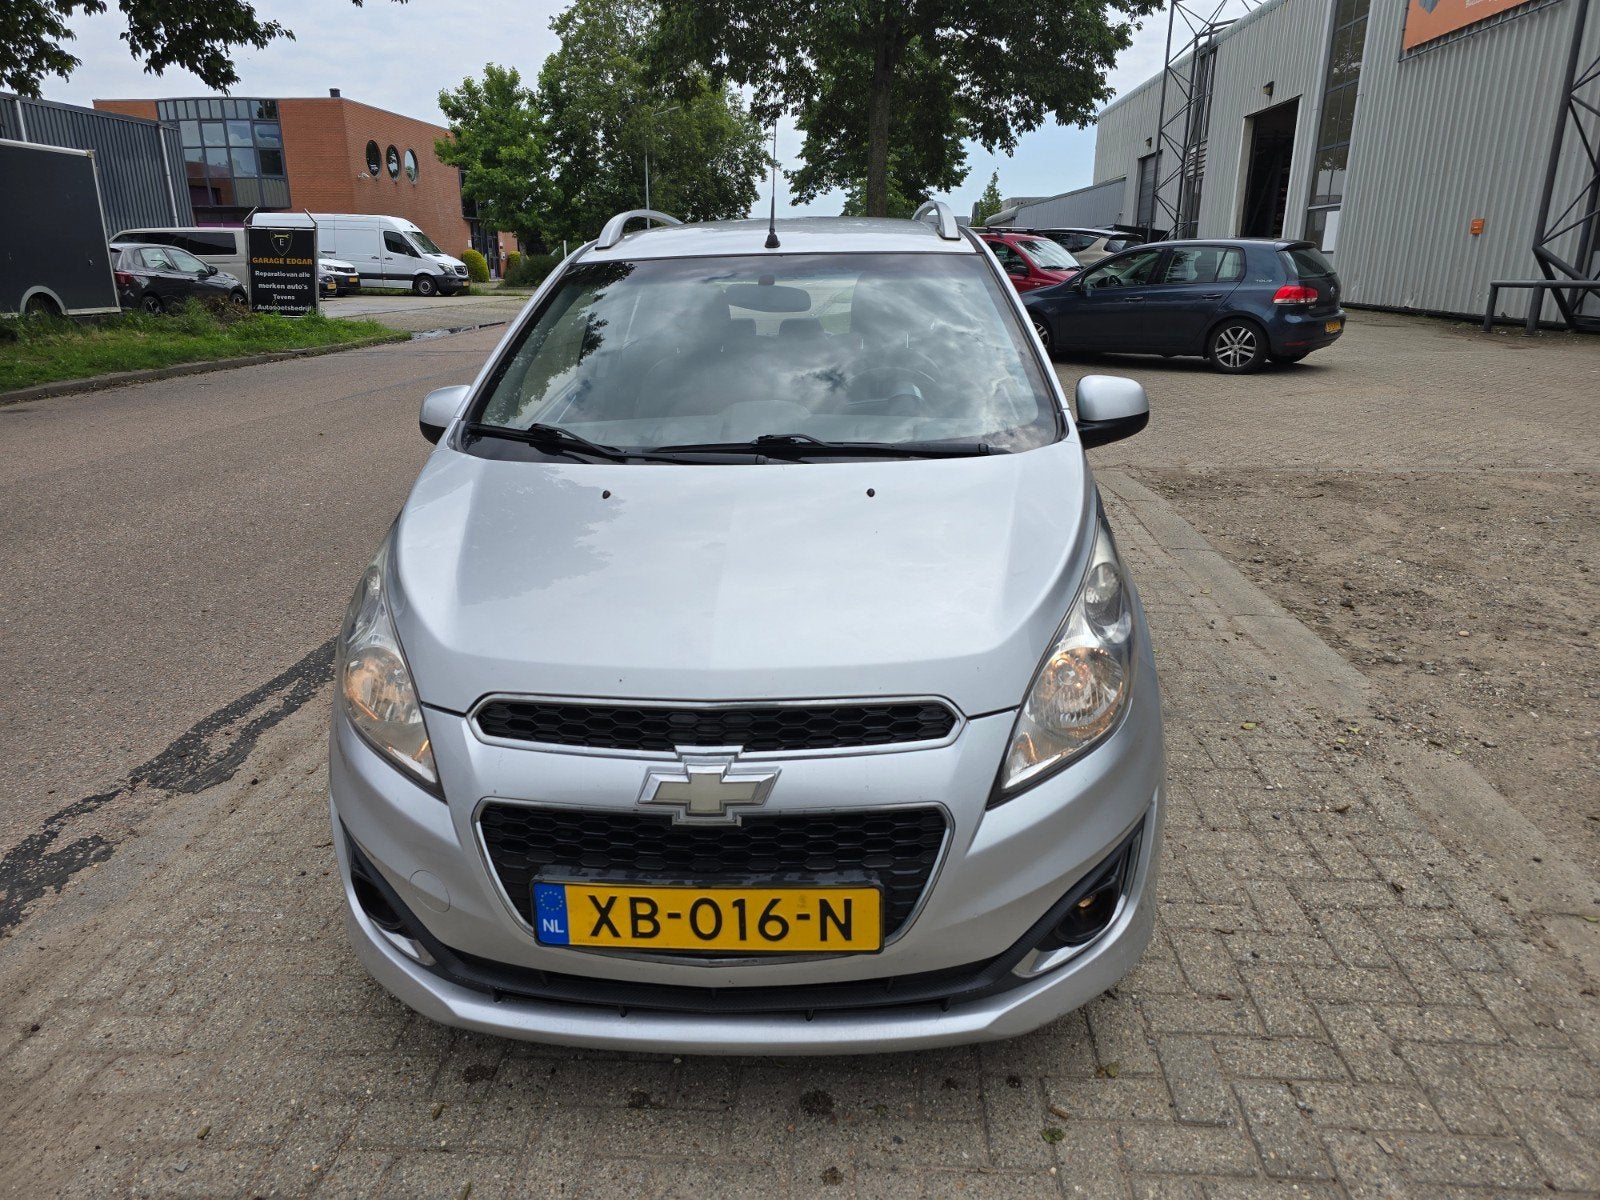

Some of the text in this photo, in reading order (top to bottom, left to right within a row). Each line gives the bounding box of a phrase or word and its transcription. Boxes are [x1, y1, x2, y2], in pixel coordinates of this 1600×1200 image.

[279, 238, 285, 246] E
[252, 257, 285, 265] GARAGE
[587, 894, 853, 942] XB-016-N
[542, 918, 565, 934] NL
